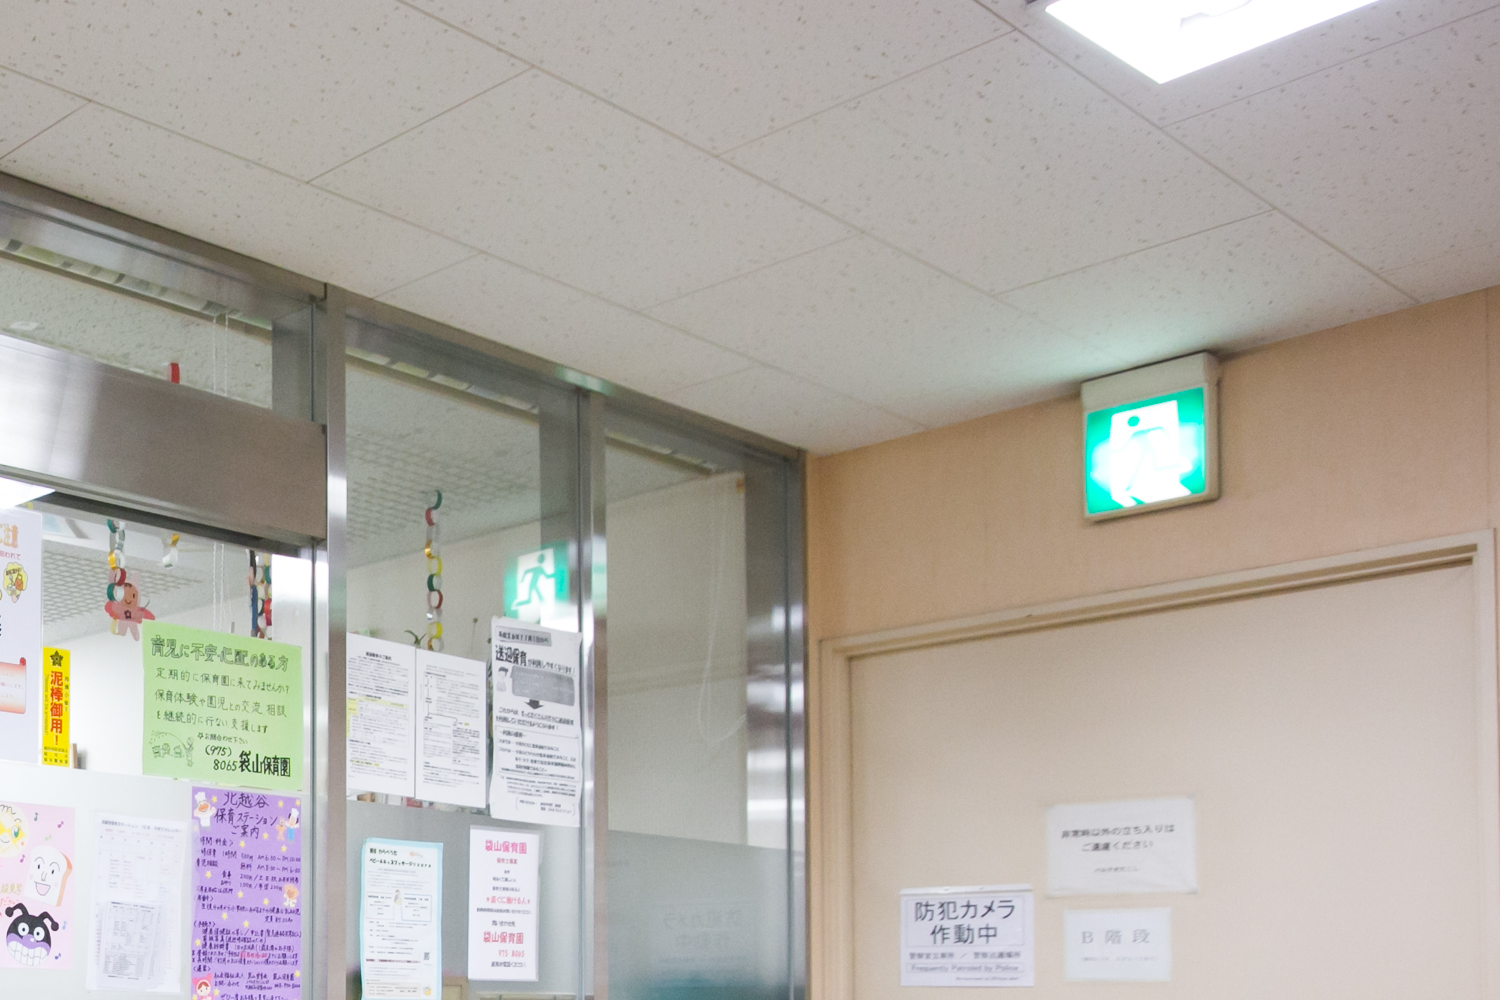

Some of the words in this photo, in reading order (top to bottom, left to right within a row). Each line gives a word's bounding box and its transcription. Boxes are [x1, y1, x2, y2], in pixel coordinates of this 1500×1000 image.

[205, 744, 233, 758] (975)
[213, 758, 238, 772] 8065
[238, 750, 291, 777] 袋山保育園
[223, 792, 270, 808] 北越谷
[214, 808, 278, 826] 保育ステーション
[231, 825, 260, 839] ご案内
[485, 839, 527, 854] 袋山保育園
[915, 899, 1015, 922] 防犯カメラ
[483, 931, 524, 945] 袋山保育園
[930, 923, 997, 945] 作動中
